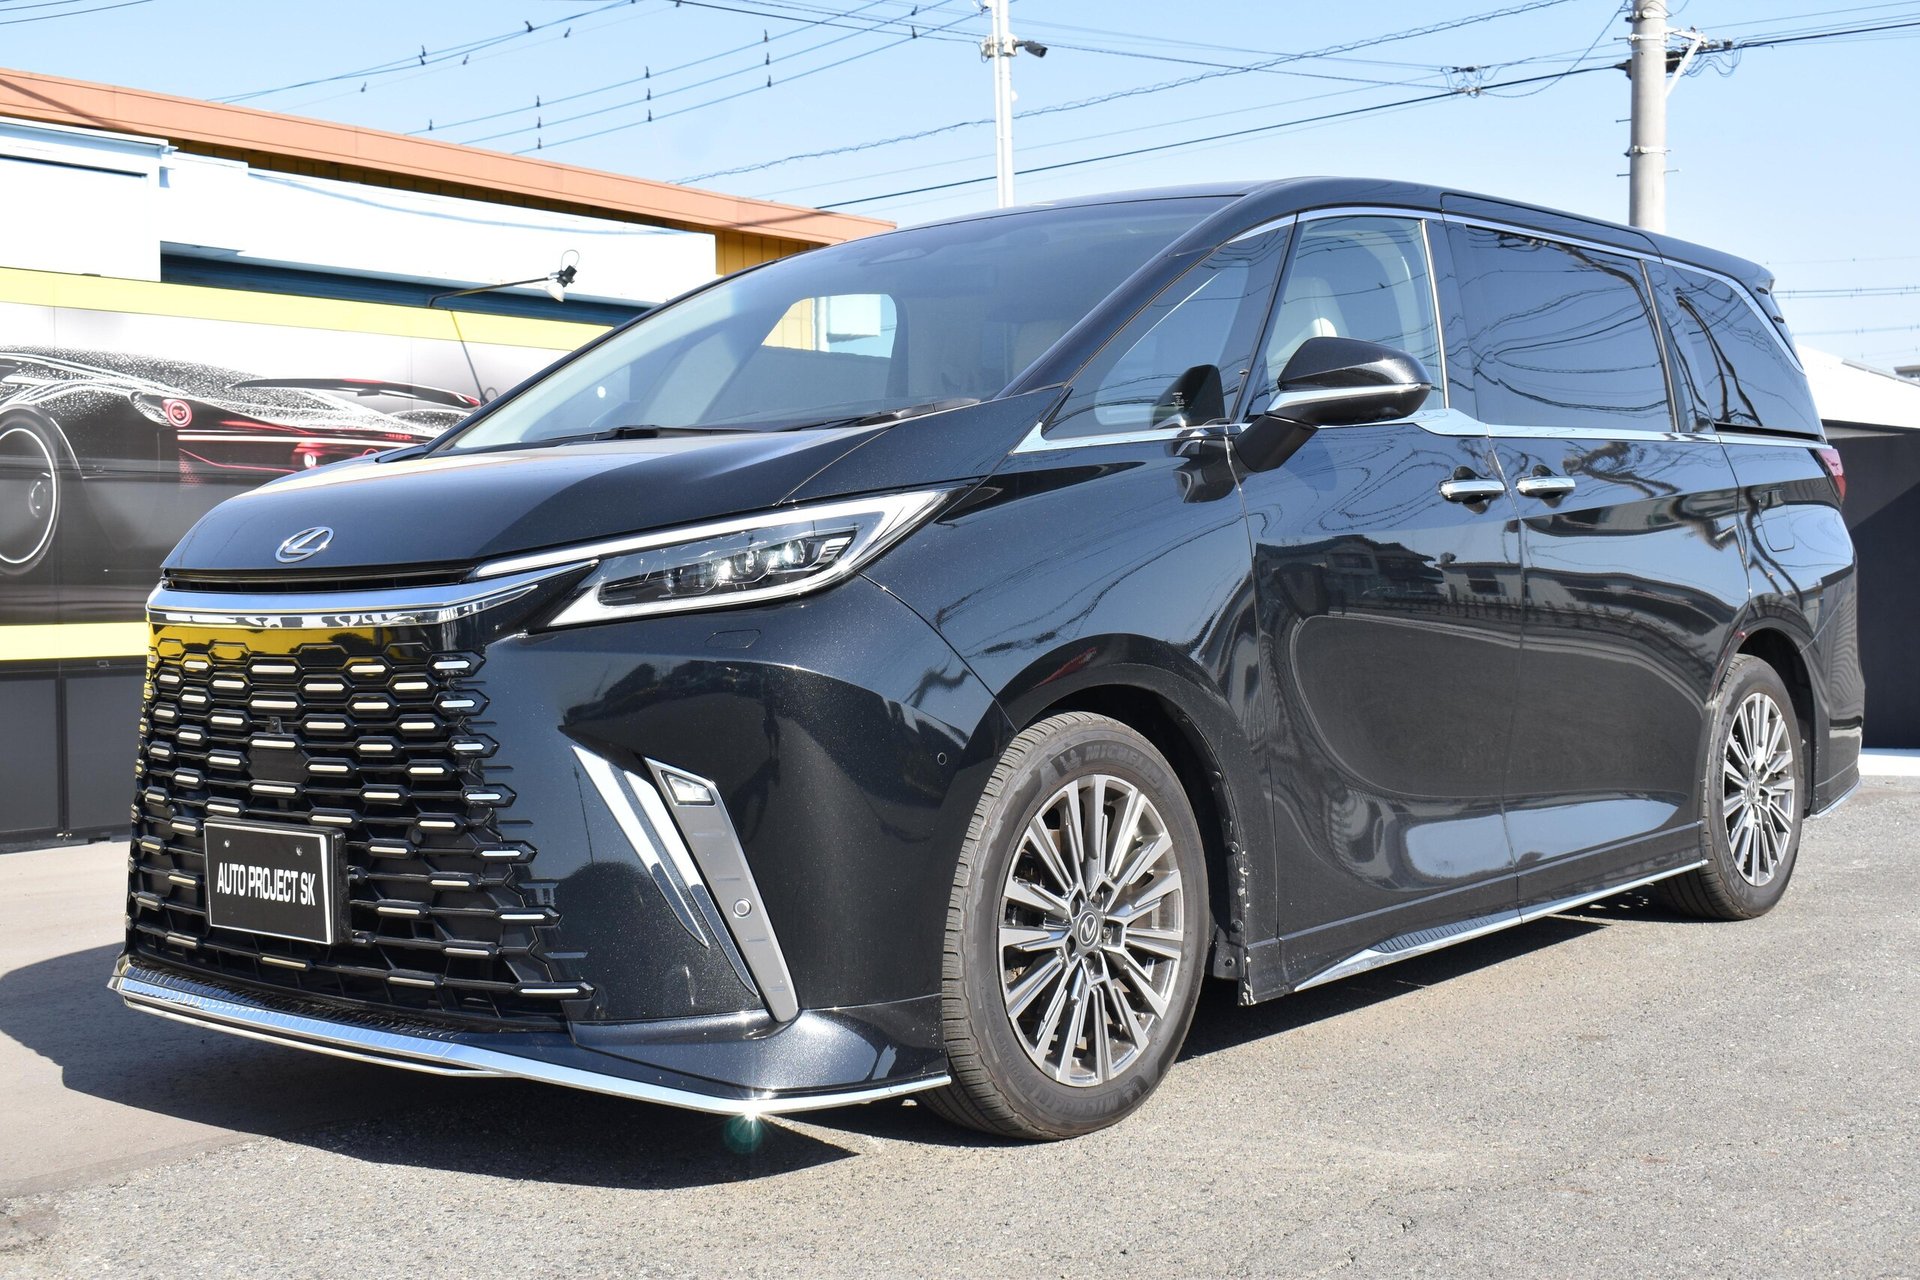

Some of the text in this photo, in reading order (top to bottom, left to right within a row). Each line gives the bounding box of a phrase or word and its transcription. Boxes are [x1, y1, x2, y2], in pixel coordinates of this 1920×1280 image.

[1085, 744, 1164, 789] MICHELIN
[216, 862, 316, 906] AUTO PROJECT SK
